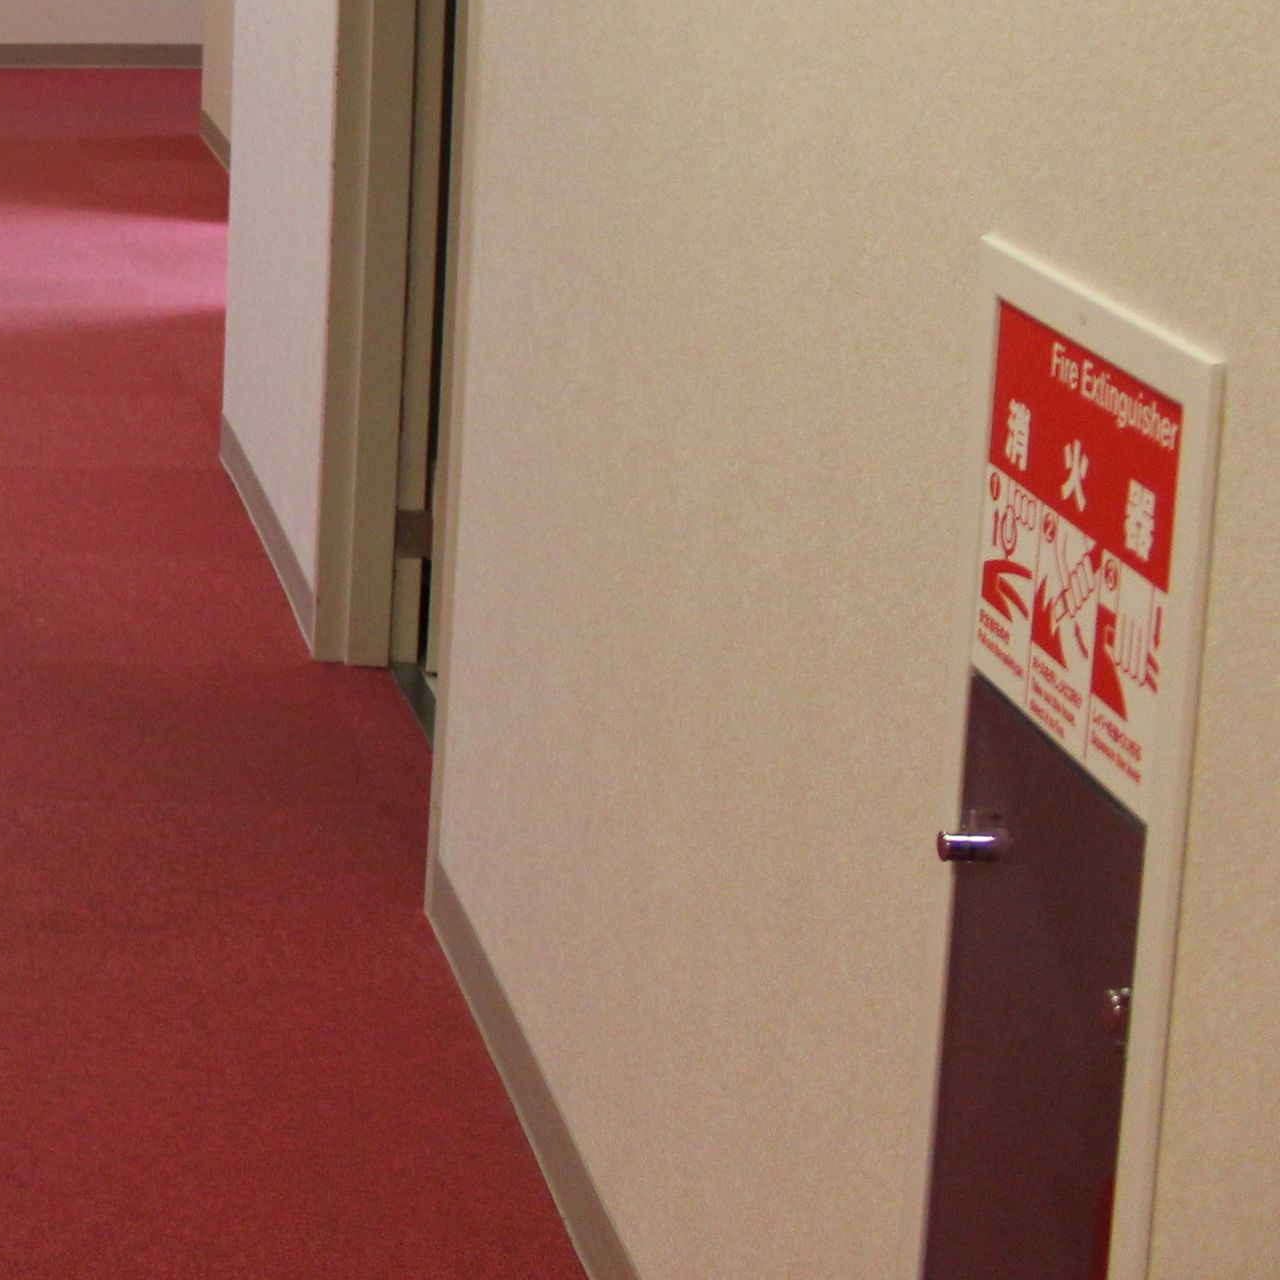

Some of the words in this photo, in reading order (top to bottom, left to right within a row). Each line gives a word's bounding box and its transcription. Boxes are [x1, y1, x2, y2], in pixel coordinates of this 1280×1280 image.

[1049, 340, 1080, 390] Fire
[1080, 359, 1178, 451] Extinguisher
[1005, 398, 1156, 562] 消火器
